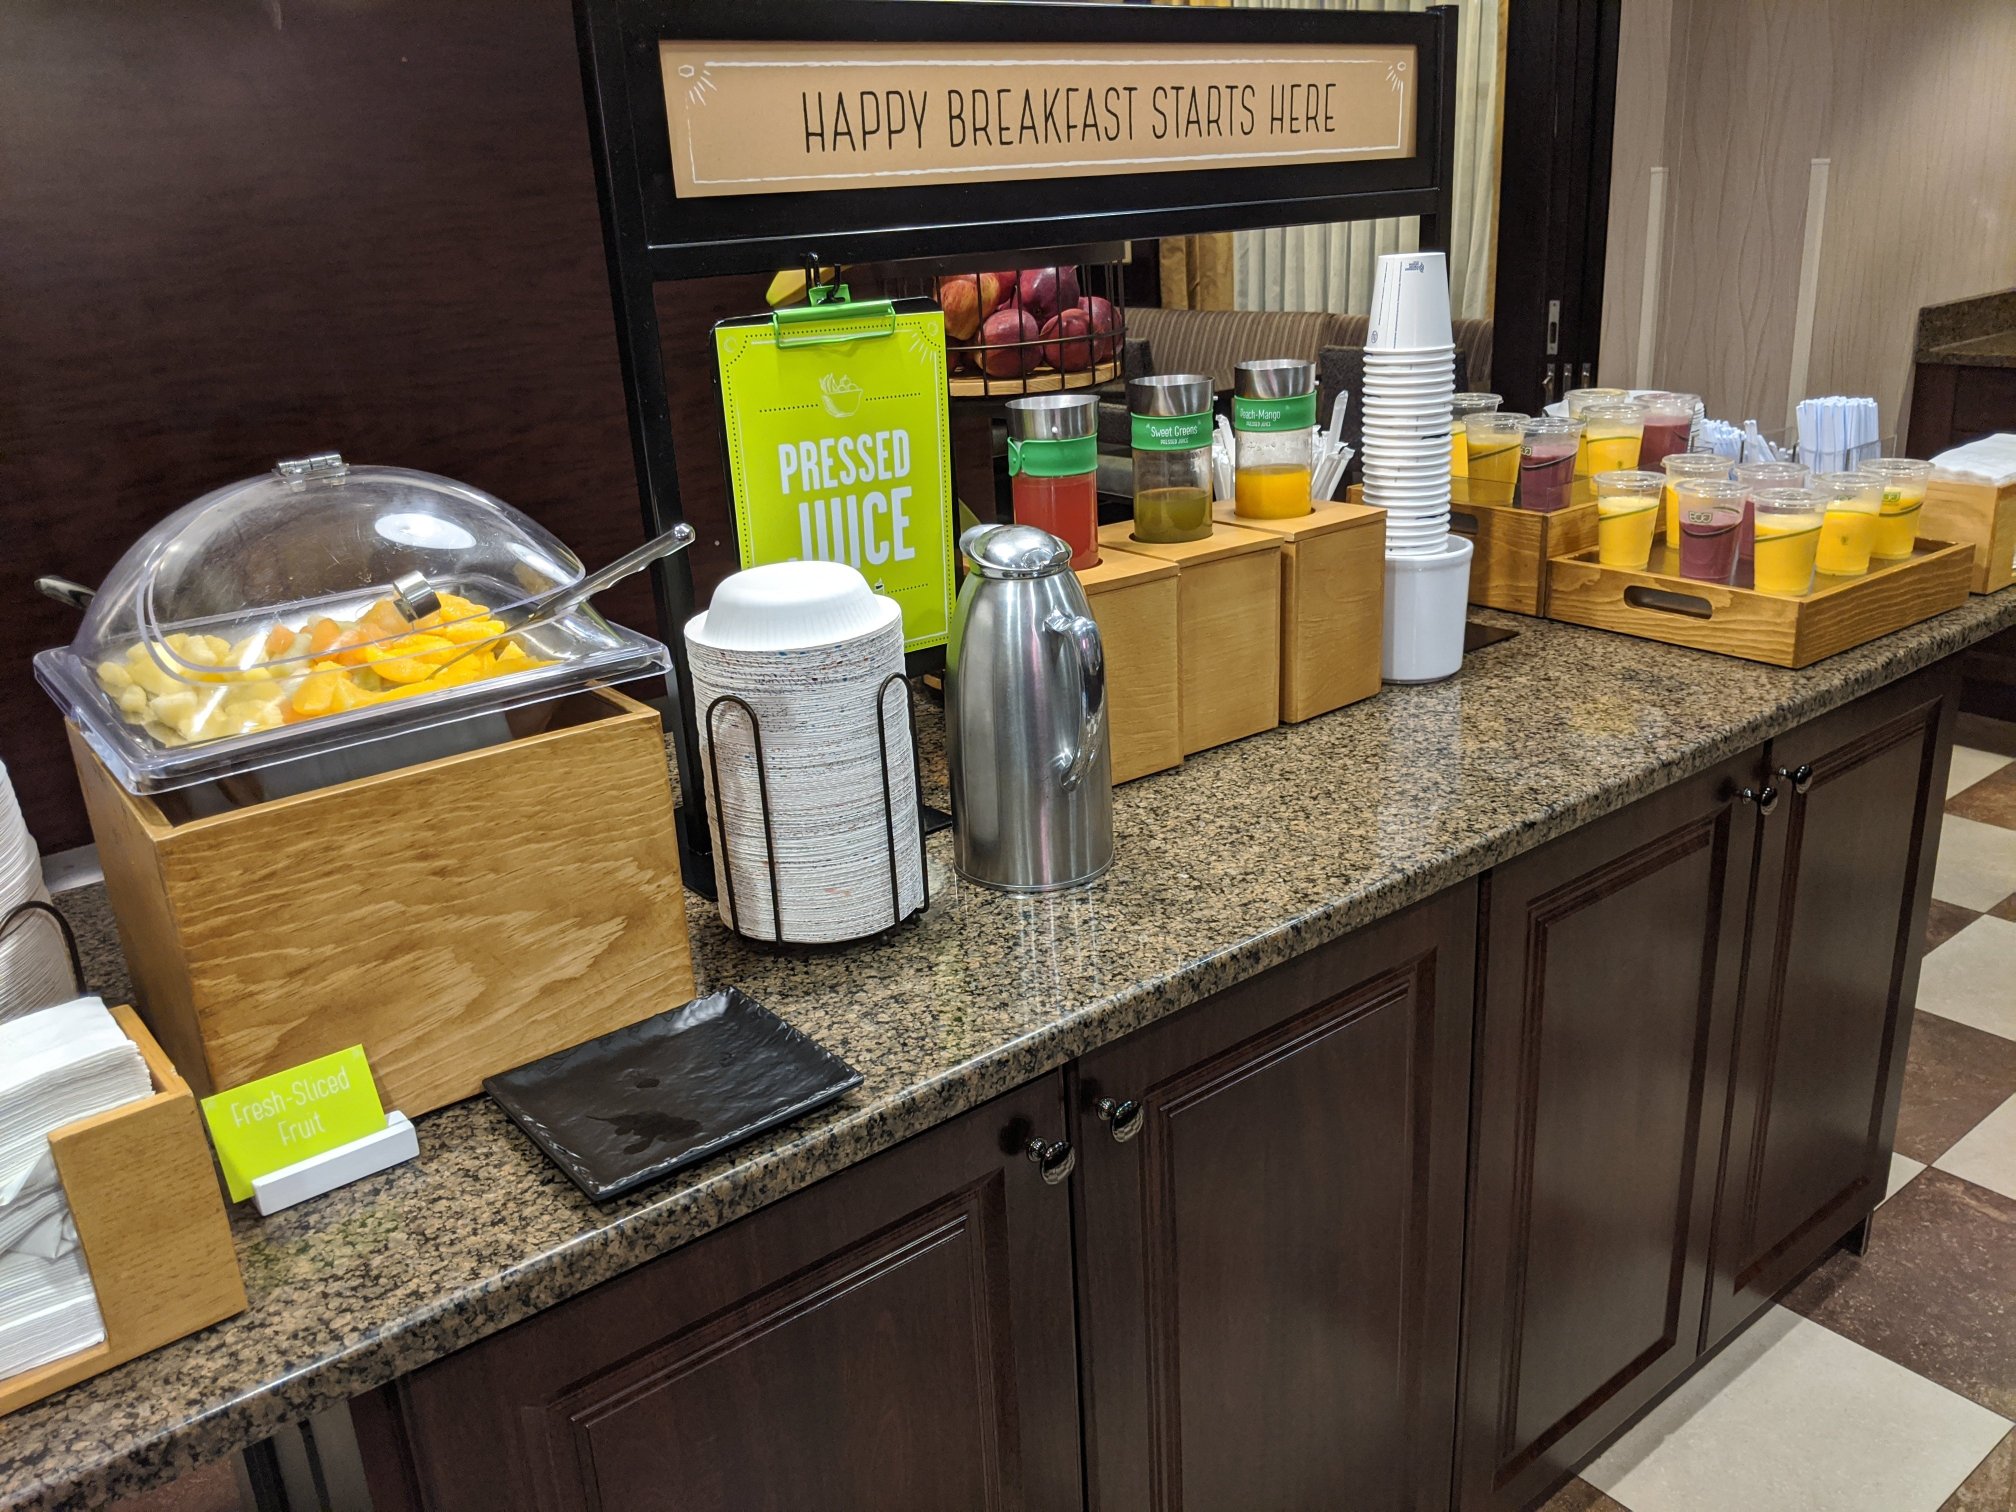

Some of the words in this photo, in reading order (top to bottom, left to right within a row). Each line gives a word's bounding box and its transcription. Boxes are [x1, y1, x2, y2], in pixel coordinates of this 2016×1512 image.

[802, 91, 928, 154] HAPPY
[947, 87, 1138, 148] BREAKFAST
[1152, 85, 1256, 140] STARTS
[1270, 83, 1337, 135] HERE
[778, 429, 911, 494] PRESSED
[1151, 426, 1173, 437] Sweet
[1174, 425, 1198, 437] Greens
[787, 486, 916, 569] JUICE
[230, 1065, 350, 1129] Fresh-Sliced
[277, 1112, 326, 1148] Fruit
